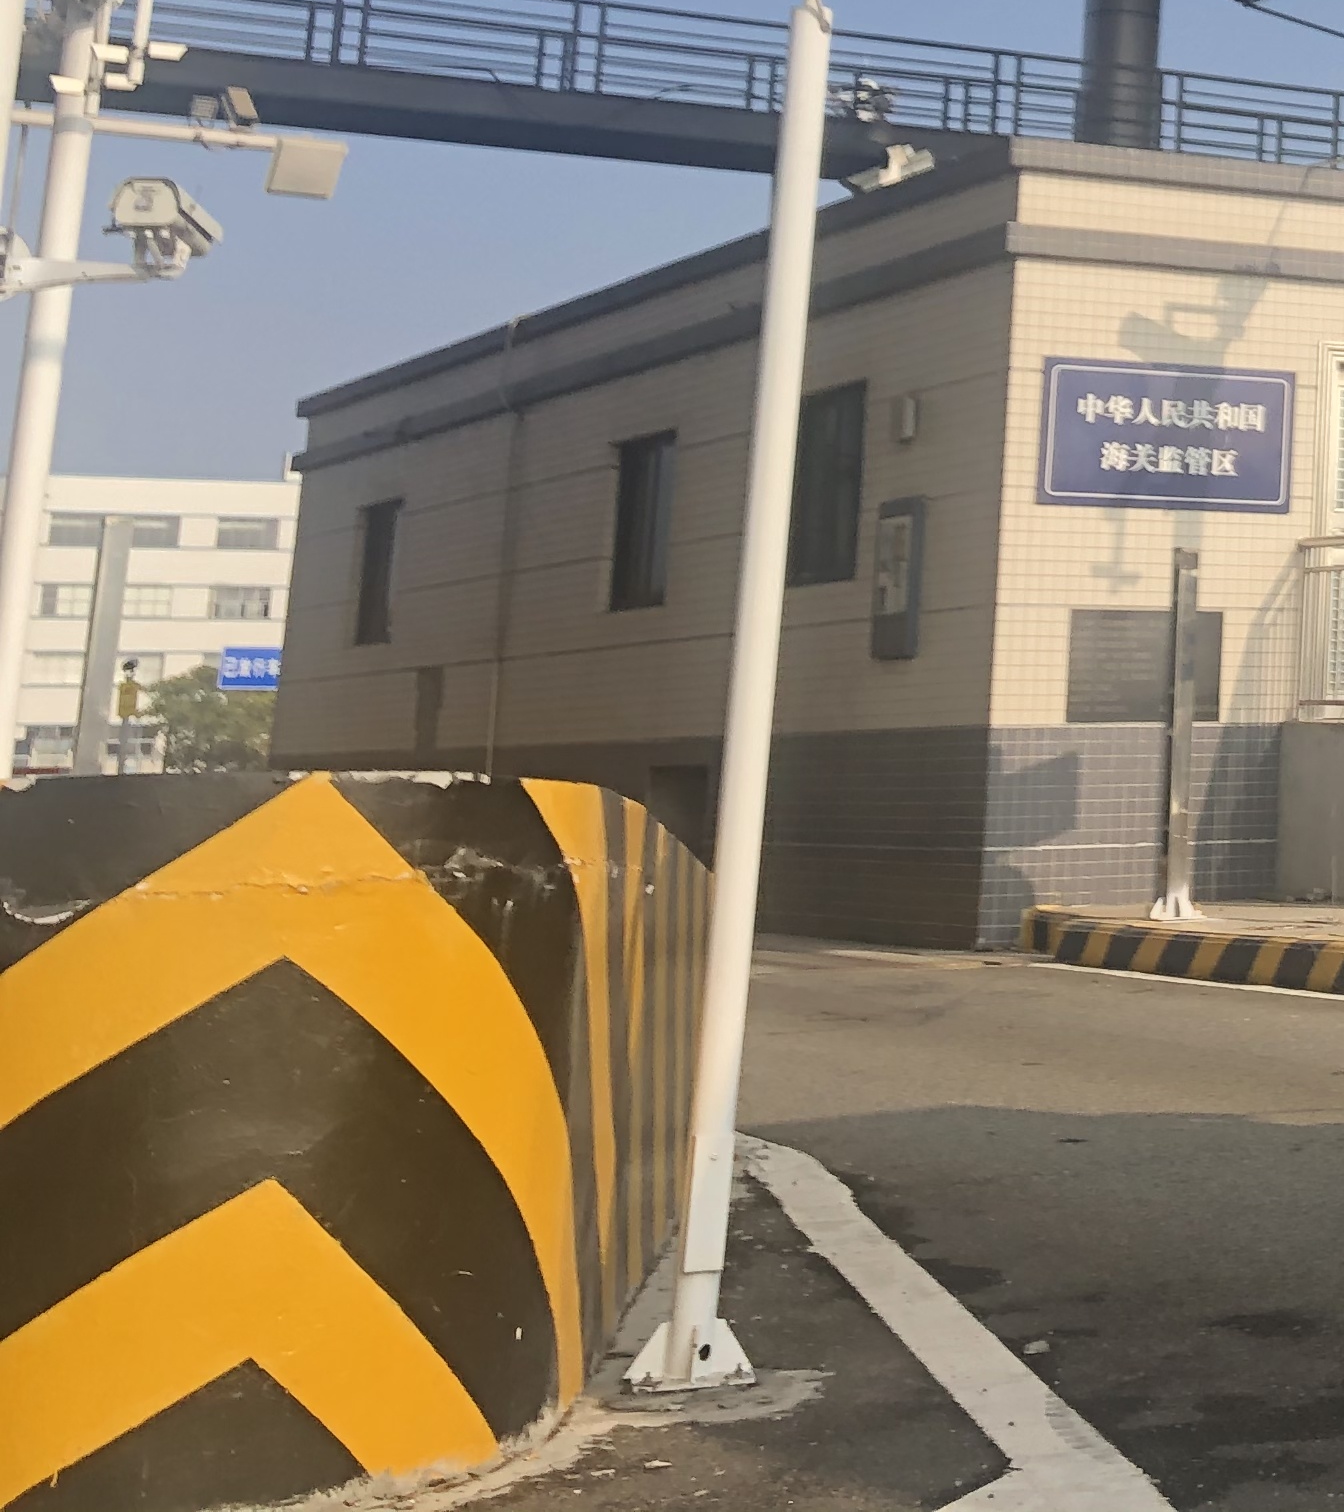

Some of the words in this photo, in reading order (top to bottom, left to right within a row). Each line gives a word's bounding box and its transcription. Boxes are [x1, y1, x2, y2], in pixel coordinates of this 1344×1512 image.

[1076, 392, 1267, 433] 中华人民共和国
[1100, 441, 1239, 477] 海关监管区
